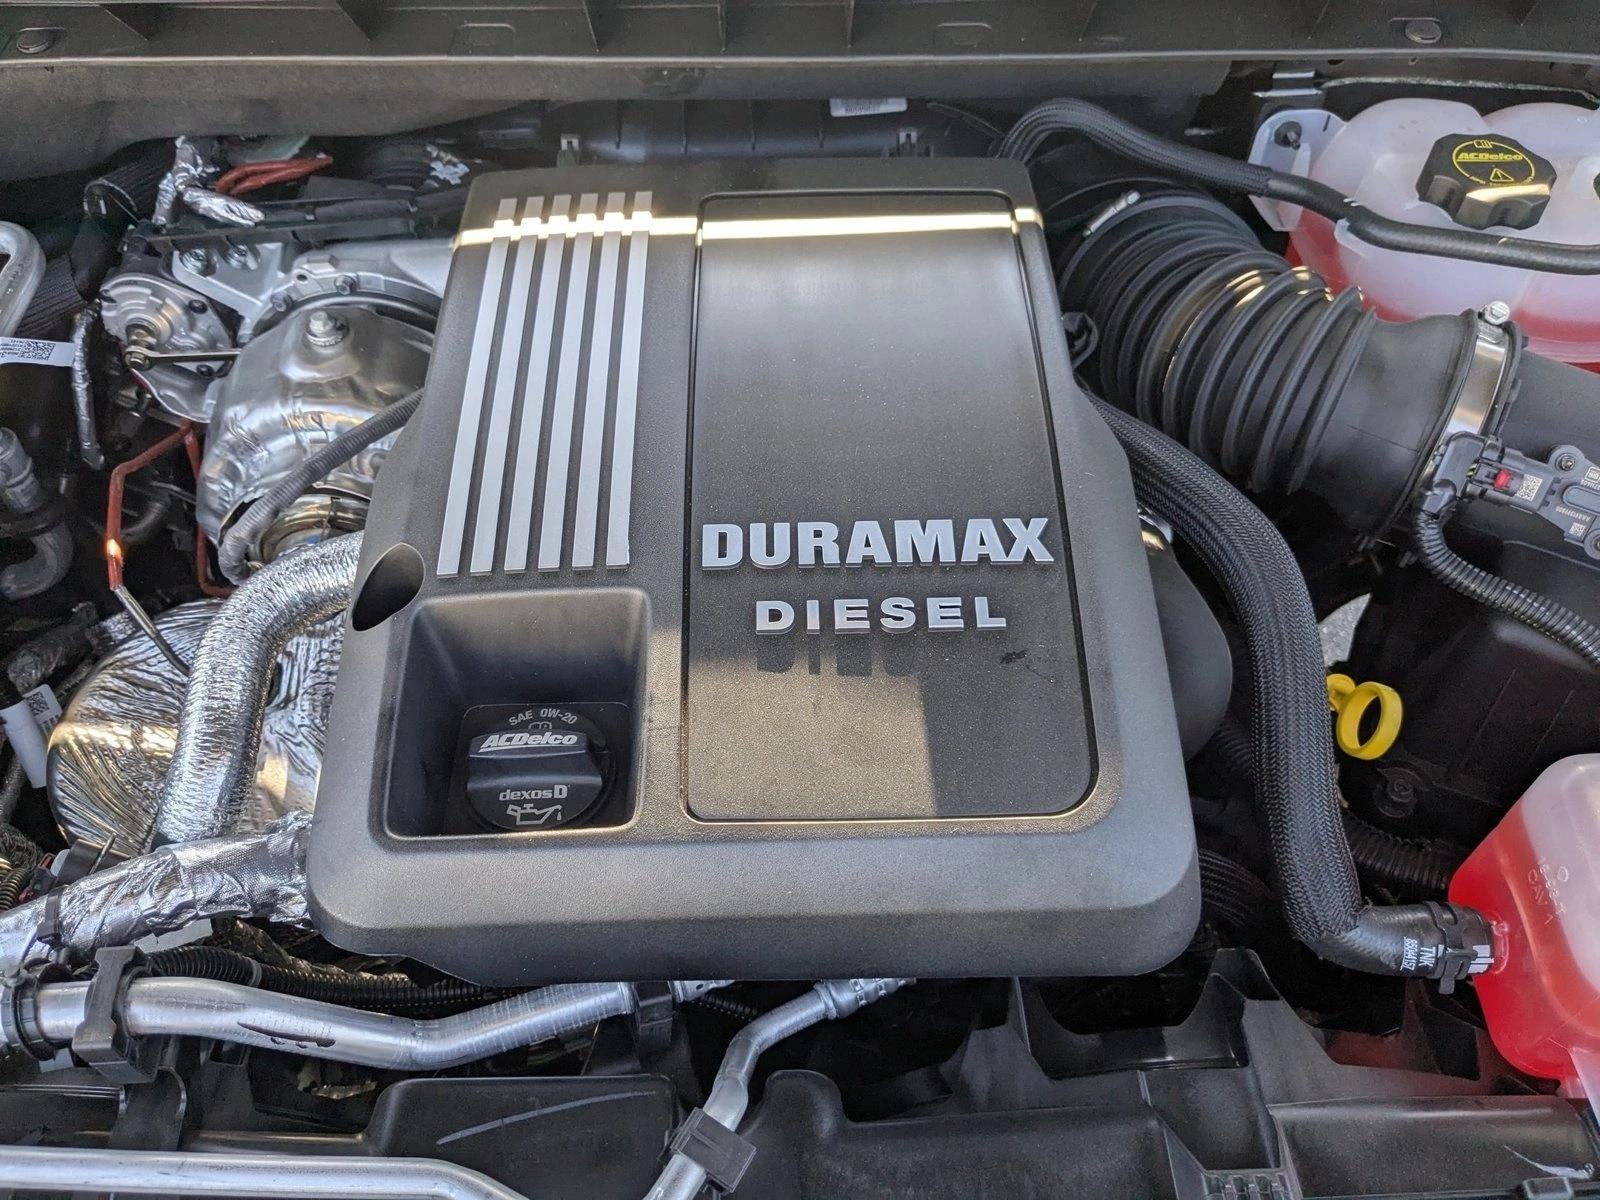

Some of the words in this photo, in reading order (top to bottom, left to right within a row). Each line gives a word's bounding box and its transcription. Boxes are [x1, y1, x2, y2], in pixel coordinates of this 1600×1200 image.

[1458, 152, 1523, 161] ACDelco
[702, 517, 1054, 570] DURAMAX
[756, 596, 1007, 634] DIESEL
[509, 710, 533, 726] SAE
[540, 708, 578, 725] 0W-20
[480, 732, 578, 749] ACDelco
[499, 784, 568, 801] dexosD
[1419, 946, 1436, 967] TNK
